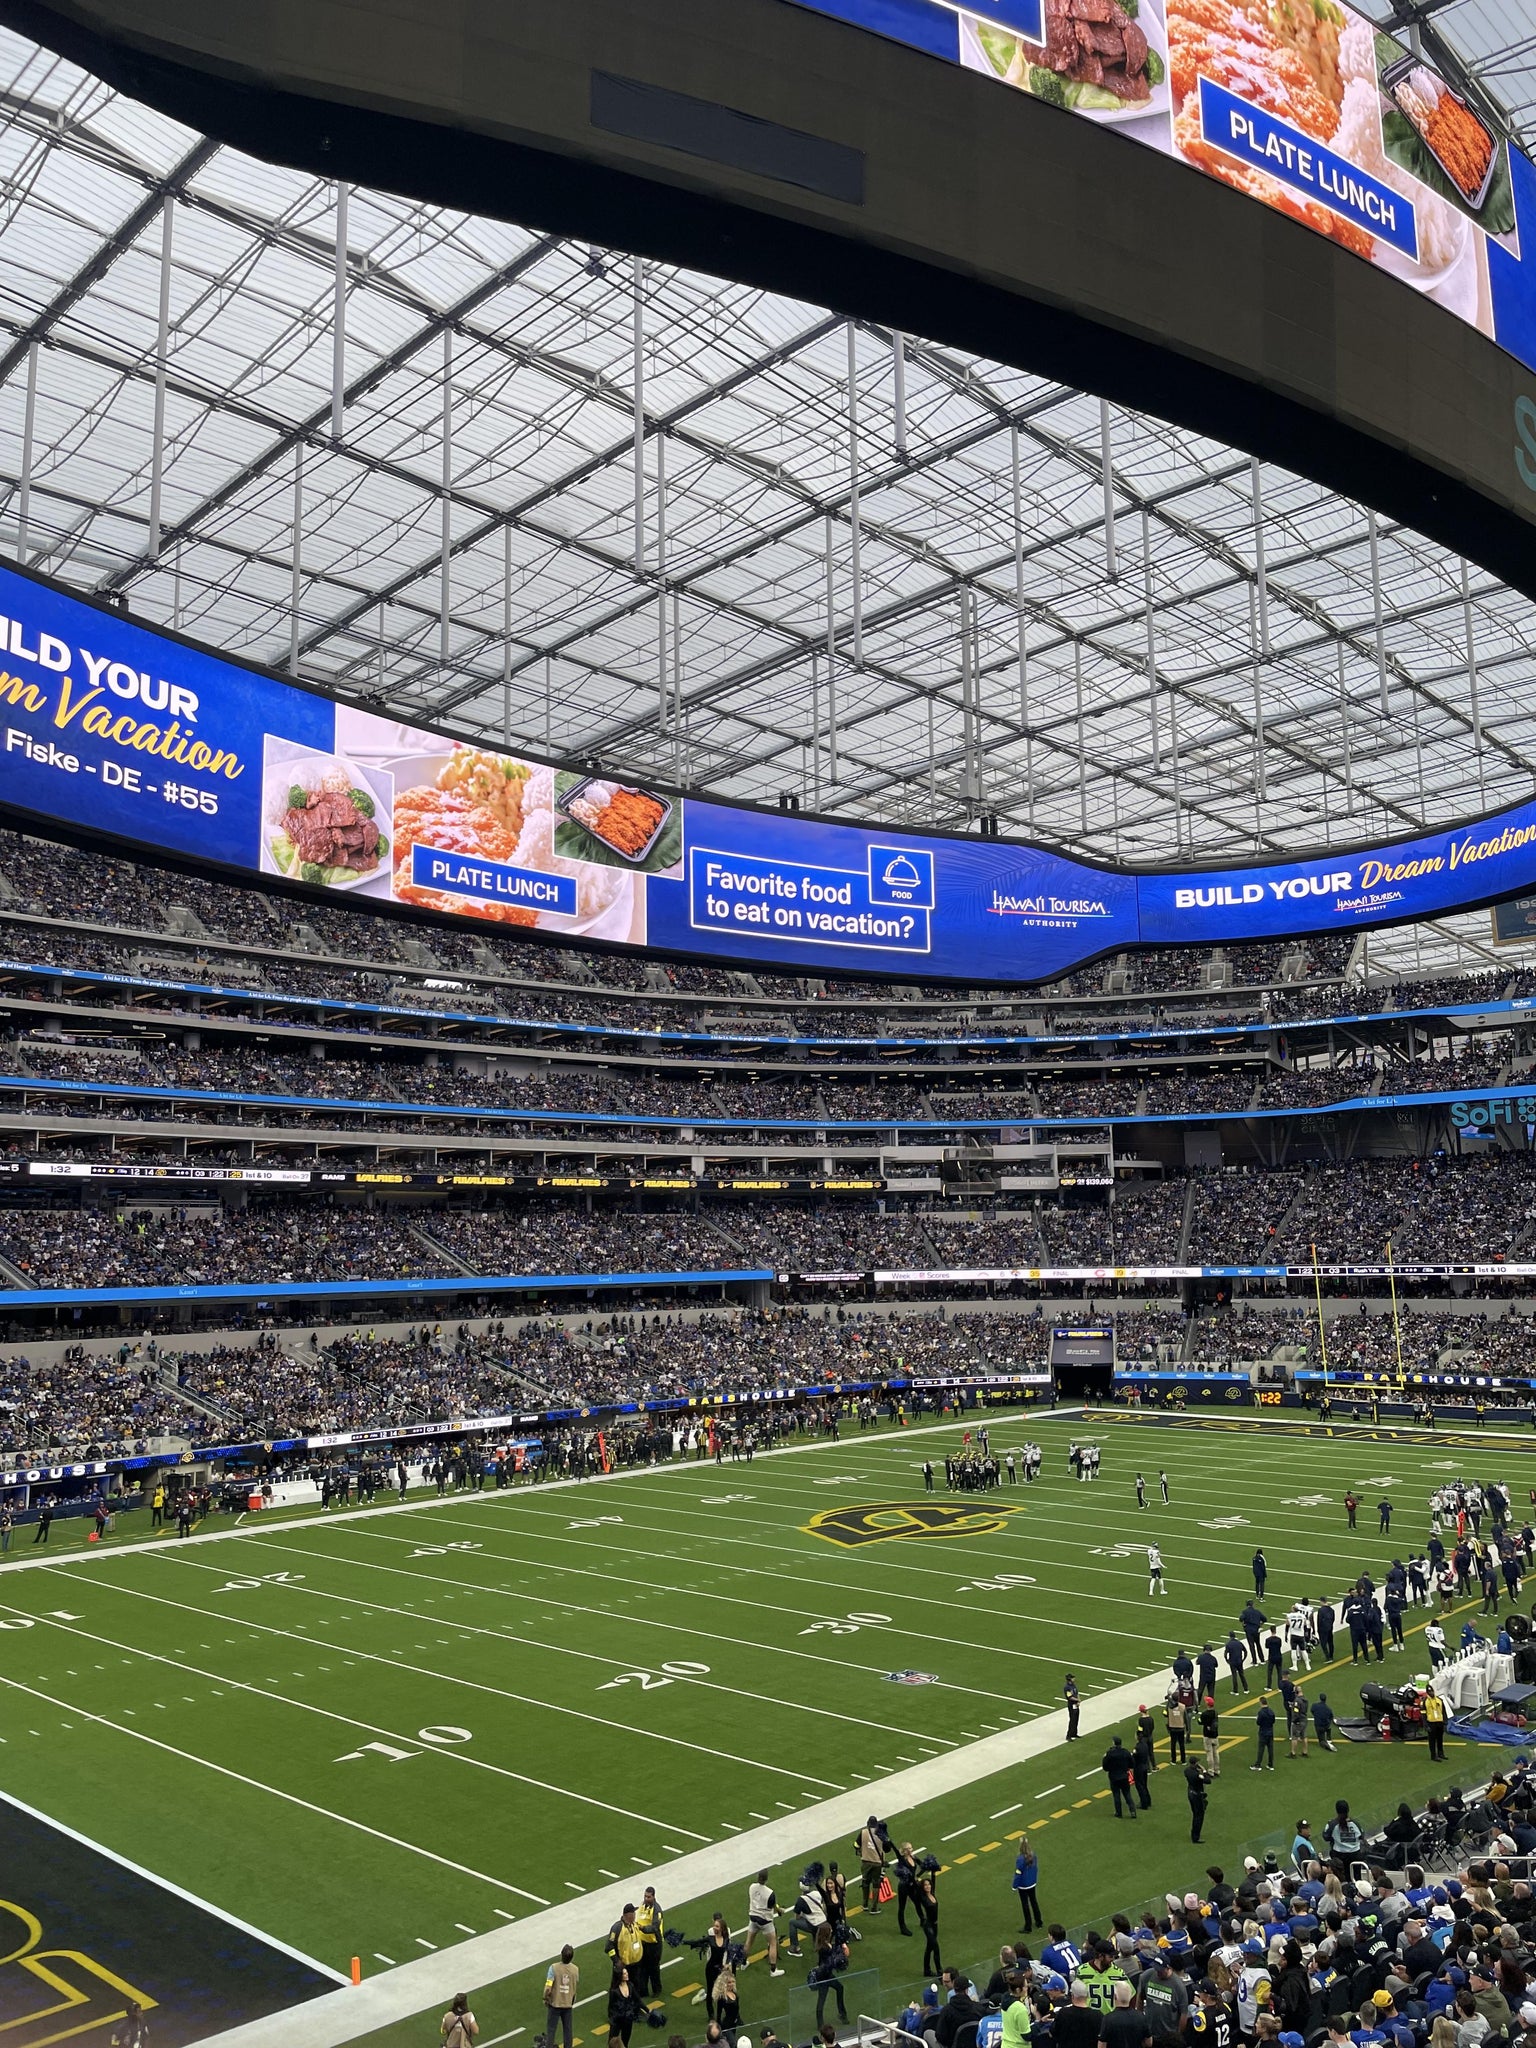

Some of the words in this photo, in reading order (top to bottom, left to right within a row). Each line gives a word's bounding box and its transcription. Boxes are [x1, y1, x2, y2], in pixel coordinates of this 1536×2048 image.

[1230, 110, 1313, 181] PLATE
[1318, 161, 1396, 232] LUNCH
[80, 648, 199, 723] YOUR
[54, 676, 245, 780] Vacation
[6, 728, 79, 773] Fiske
[85, 765, 97, 774] -
[102, 760, 142, 793] DE
[146, 785, 158, 793] -
[163, 780, 218, 815] #55
[1175, 884, 1265, 908] BUILD
[1268, 871, 1353, 900] YOUR
[1359, 856, 1446, 889] Dream
[1449, 824, 1536, 871] Vacation
[432, 860, 492, 890] PLATE
[496, 873, 559, 903] LUNCH
[706, 863, 797, 900] Favorite
[801, 877, 851, 905] food
[891, 890, 913, 900] FOOD
[1370, 890, 1402, 901] TOURISM
[1515, 899, 1536, 910] 199
[706, 895, 730, 918] to
[733, 902, 771, 922] eat
[774, 909, 801, 926] on
[806, 911, 915, 938] vacation?
[1049, 898, 1106, 915] TOURISM
[1354, 904, 1387, 914] AUTHORITY
[1023, 919, 1078, 928] AUTHORITY
[1451, 1099, 1513, 1127] SoFi
[11, 1163, 20, 1172] 5
[50, 1165, 71, 1173] 1:32
[891, 1272, 910, 1280] Week
[1364, 1373, 1423, 1383] RAMS
[1428, 1375, 1501, 1387] HOUSE
[688, 1394, 736, 1406] RAMS
[740, 1389, 796, 1401] HOUSE
[4, 1462, 107, 1486] HOUSE
[413, 1541, 483, 1557] 30
[225, 1571, 306, 1590] 20
[971, 1574, 1037, 1591] 40
[0, 1609, 86, 1632] 10
[811, 1612, 893, 1635] 30
[1290, 1619, 1303, 1629] 77
[614, 1661, 711, 1691] 20
[356, 1725, 473, 1763] 10
[1061, 1948, 1080, 1969] 11
[1088, 1983, 1115, 2010] 54
[1147, 1987, 1173, 2003] SEAHAWKS
[1215, 2023, 1230, 2048] 12
